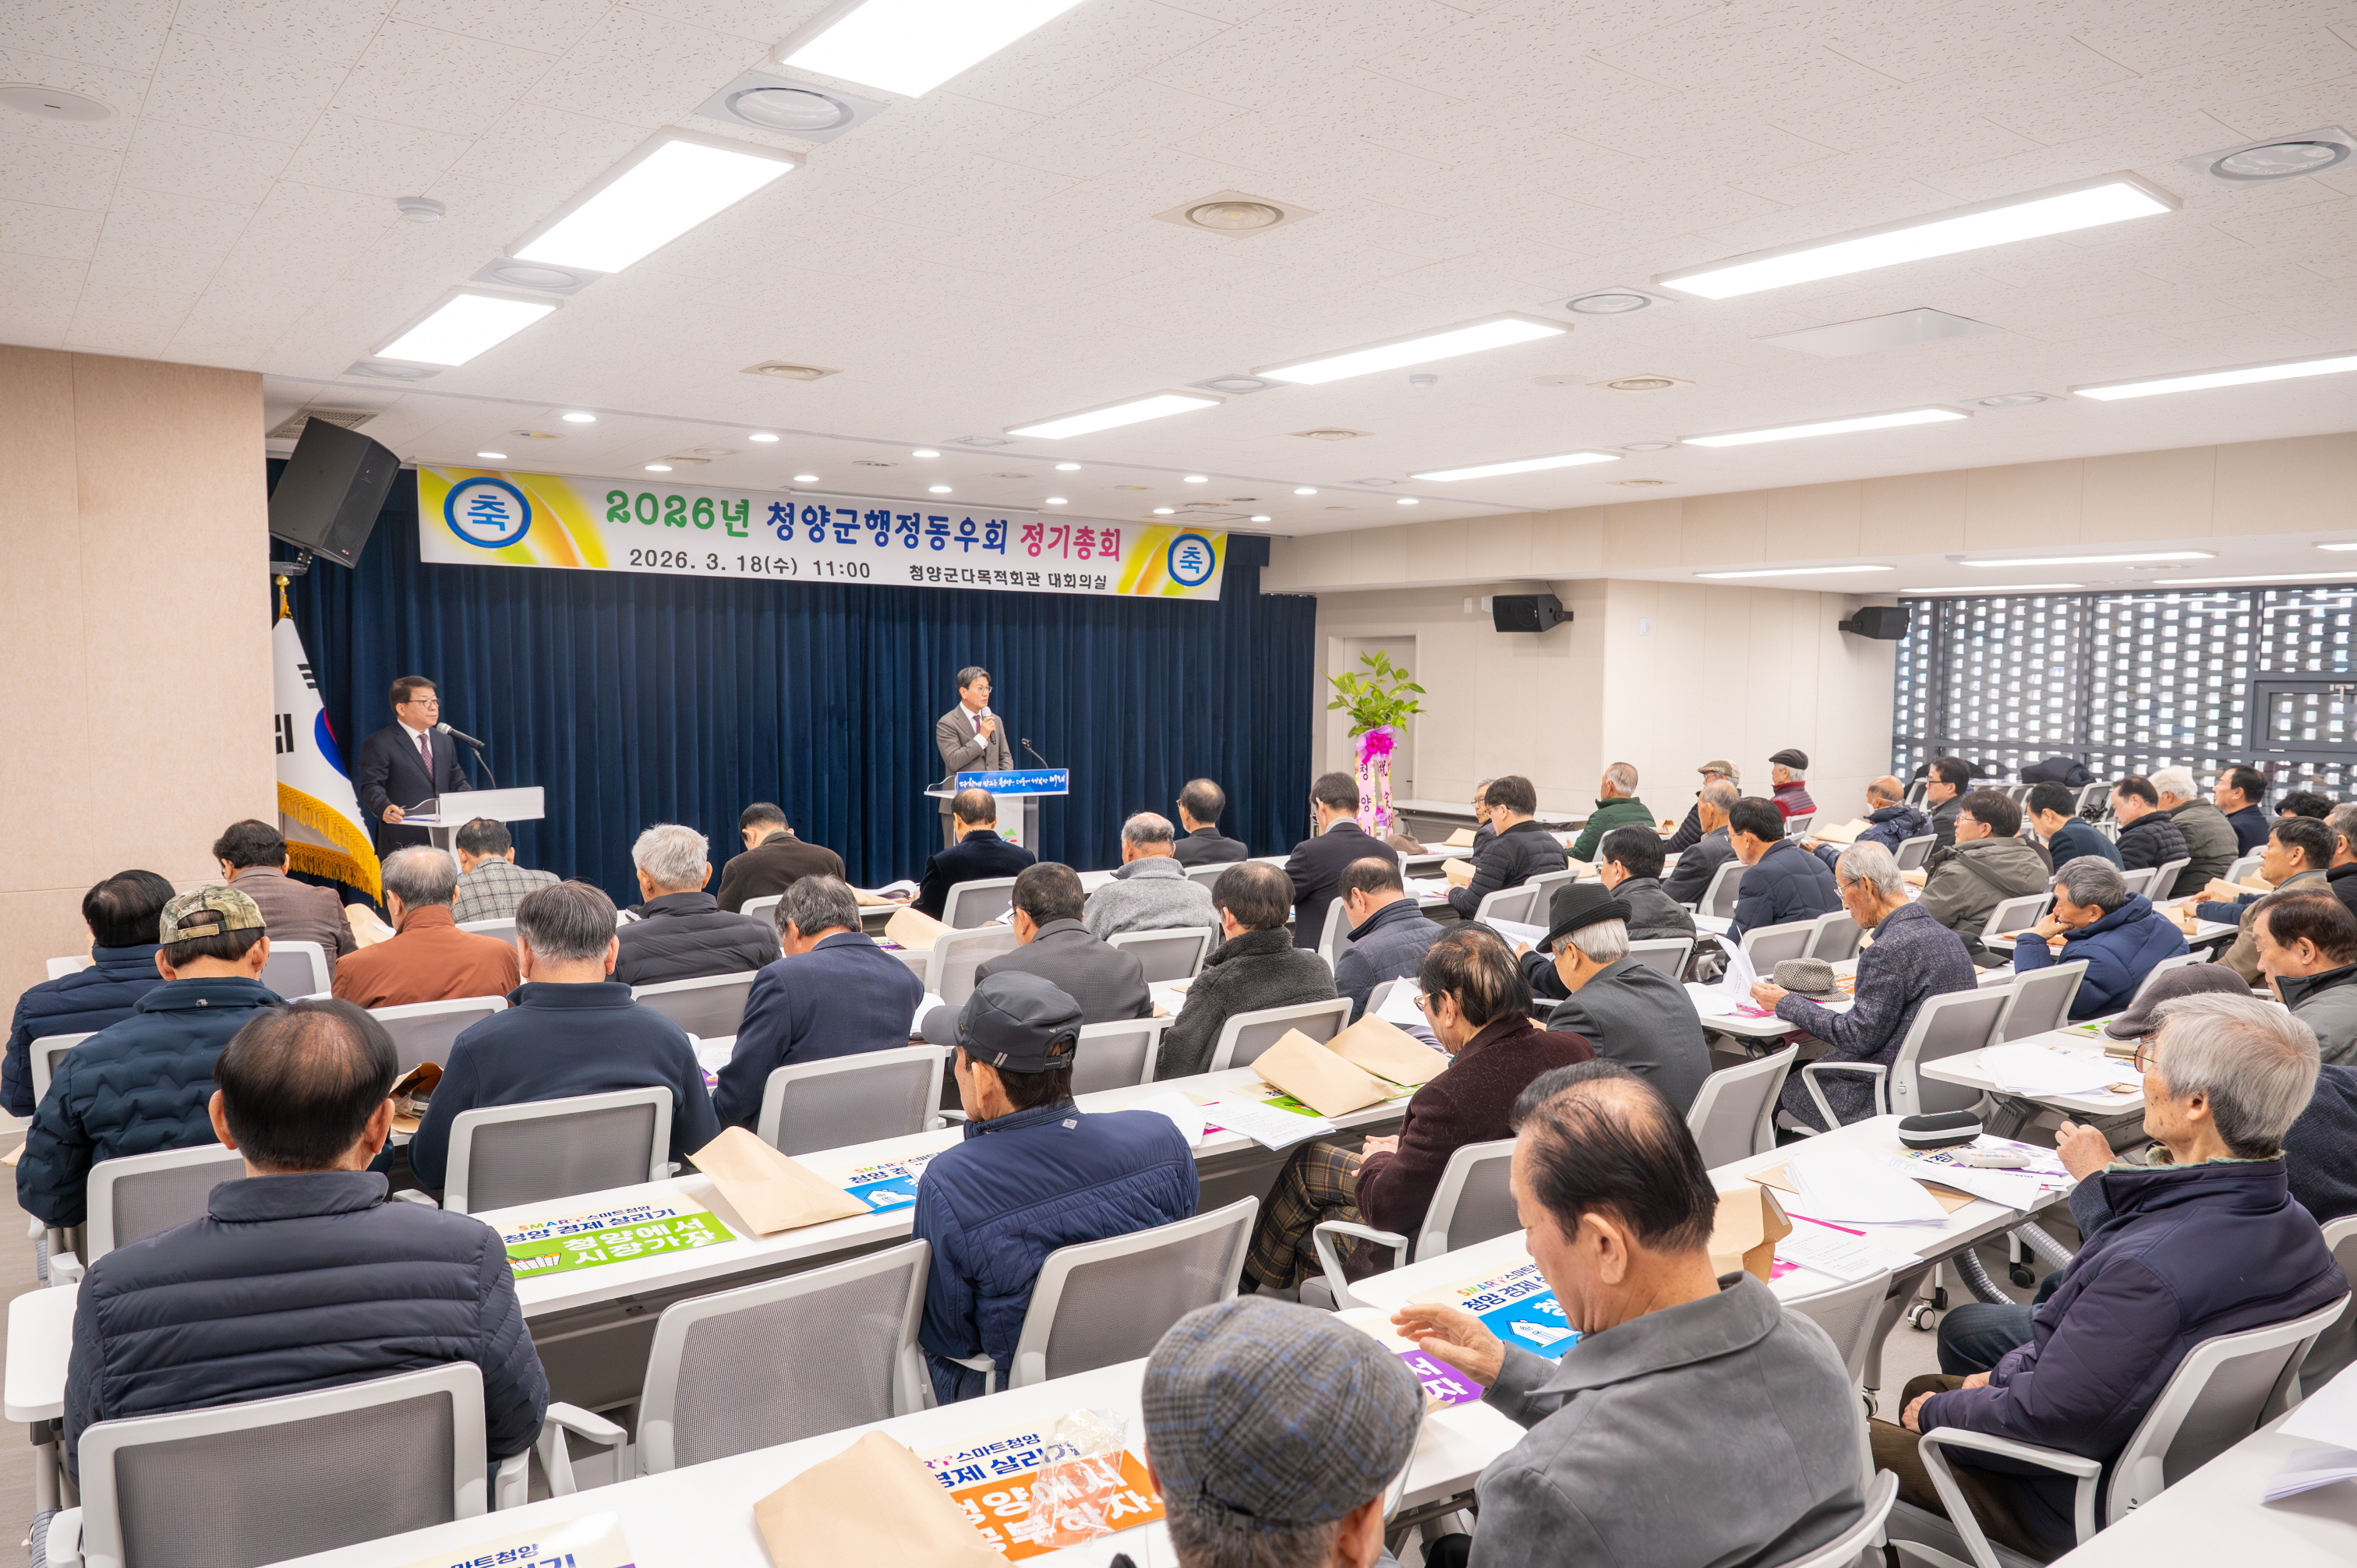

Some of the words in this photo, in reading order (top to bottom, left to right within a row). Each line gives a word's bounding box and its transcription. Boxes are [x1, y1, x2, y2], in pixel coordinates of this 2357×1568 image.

[467, 494, 510, 531] 축
[606, 489, 750, 539] 2026년
[766, 500, 1009, 556] 청양군행정동우회
[1019, 521, 1121, 562] 정기총회
[630, 548, 696, 570] 2026.
[705, 553, 726, 571] 3.
[736, 554, 798, 576] 18(수)
[812, 560, 871, 579] 11:00
[1178, 546, 1203, 575] 축
[909, 563, 1041, 588] 청양군다목적회관
[1048, 570, 1108, 591] 대회의실
[848, 1171, 889, 1184] 청양
[504, 1228, 552, 1244] 청양
[557, 1220, 603, 1234] 경제
[609, 1208, 677, 1226] 살리기
[585, 1205, 651, 1221] 스마트청양
[563, 1217, 706, 1252] 청양에서
[574, 1231, 716, 1265] 시장가자
[1461, 1292, 1507, 1311] 청양
[1497, 1280, 1543, 1298] 경제
[956, 1433, 1041, 1462] 스마트청양
